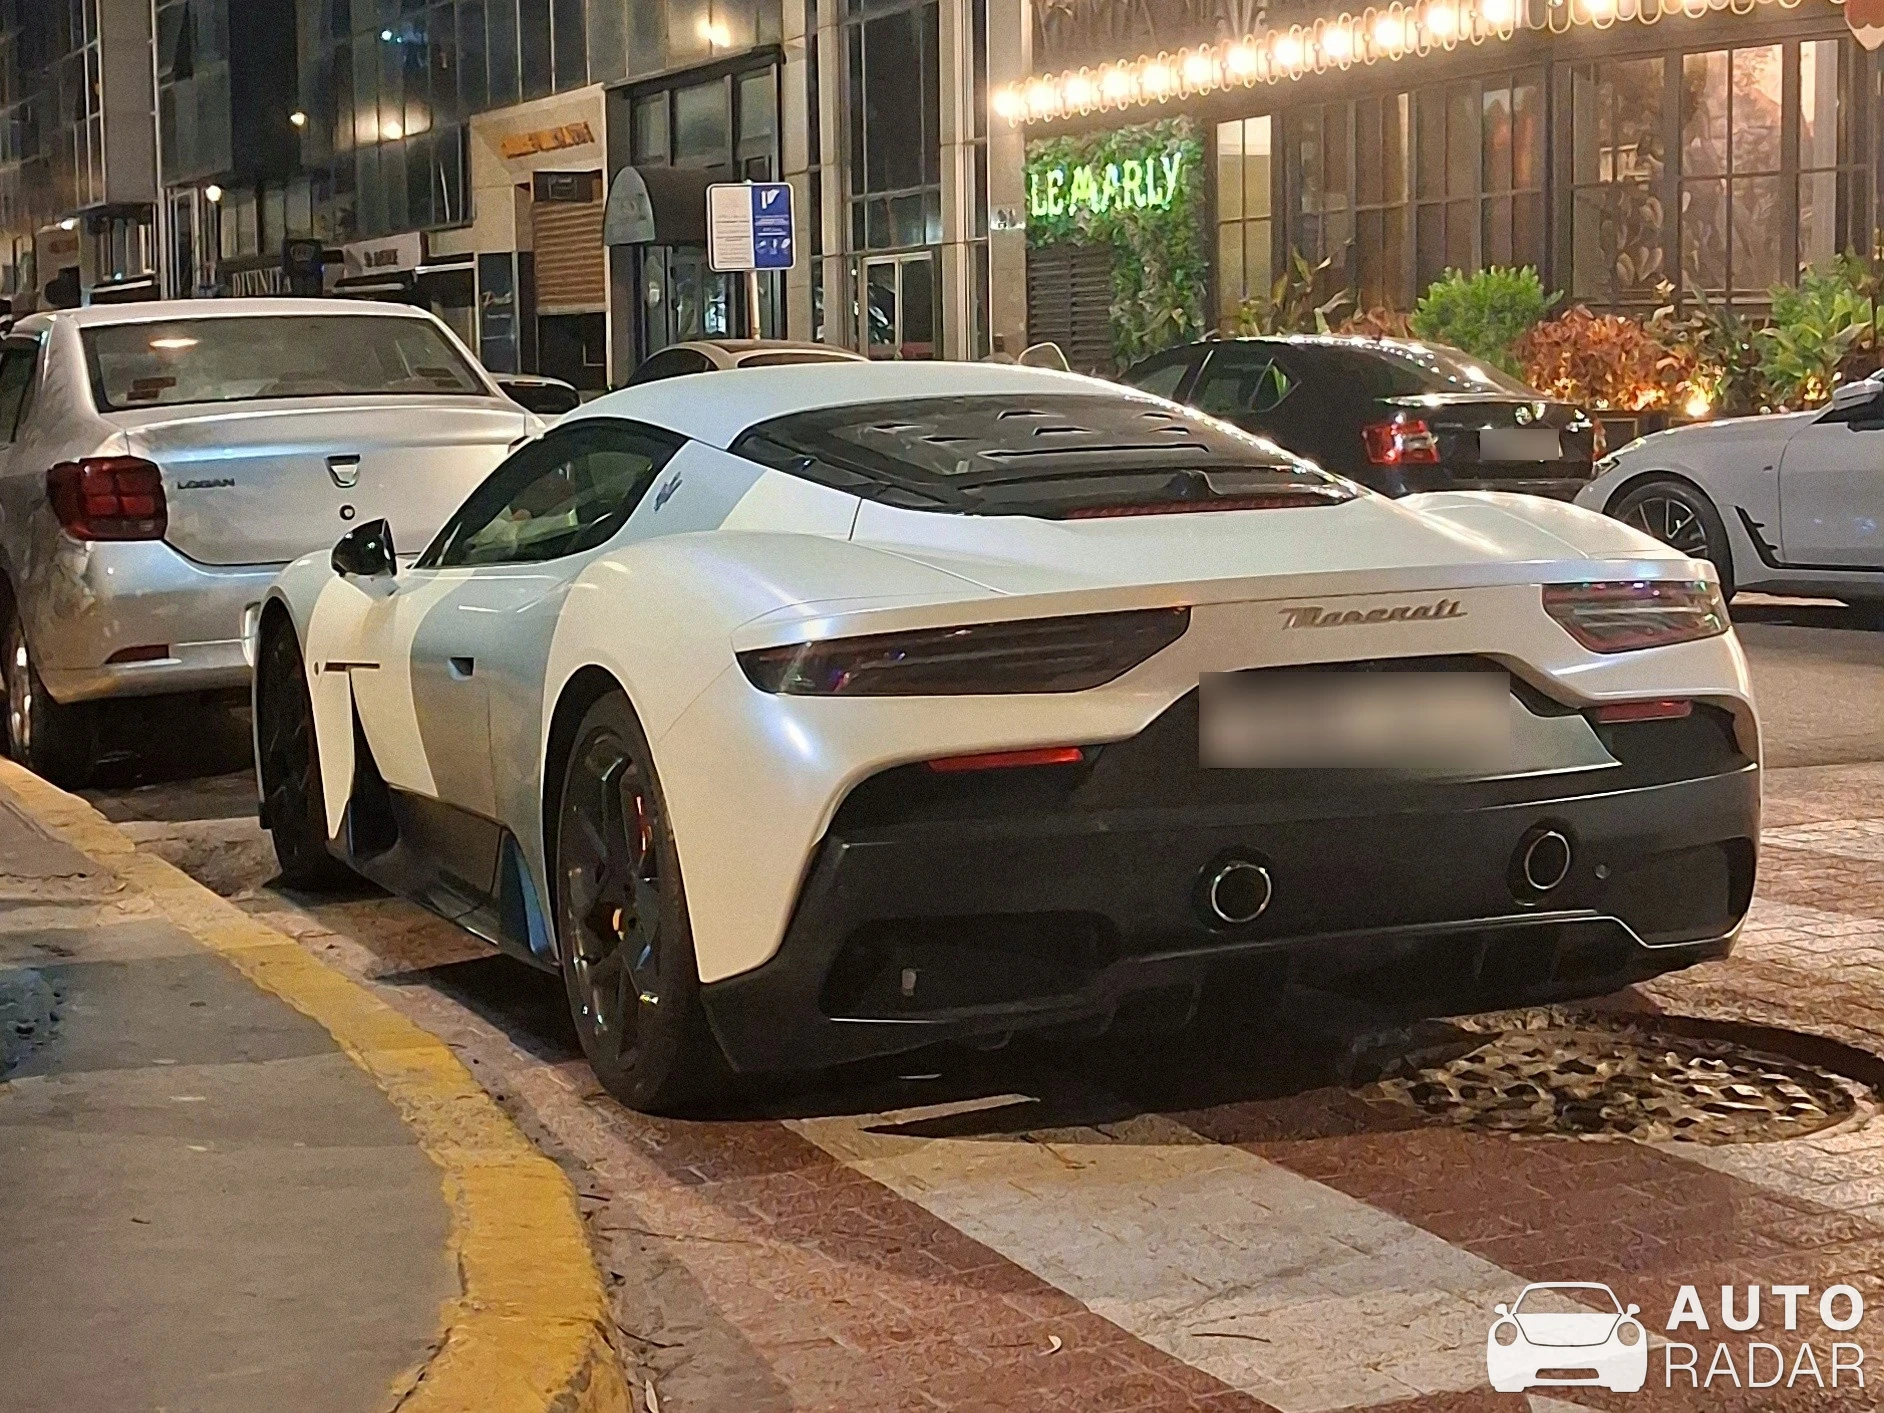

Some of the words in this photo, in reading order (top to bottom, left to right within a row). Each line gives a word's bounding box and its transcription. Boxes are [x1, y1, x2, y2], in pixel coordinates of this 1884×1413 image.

[1029, 168, 1064, 217] LE
[1067, 151, 1182, 217] MARLY
[177, 478, 236, 489] LOGAN
[1278, 598, 1468, 631] Maserati
